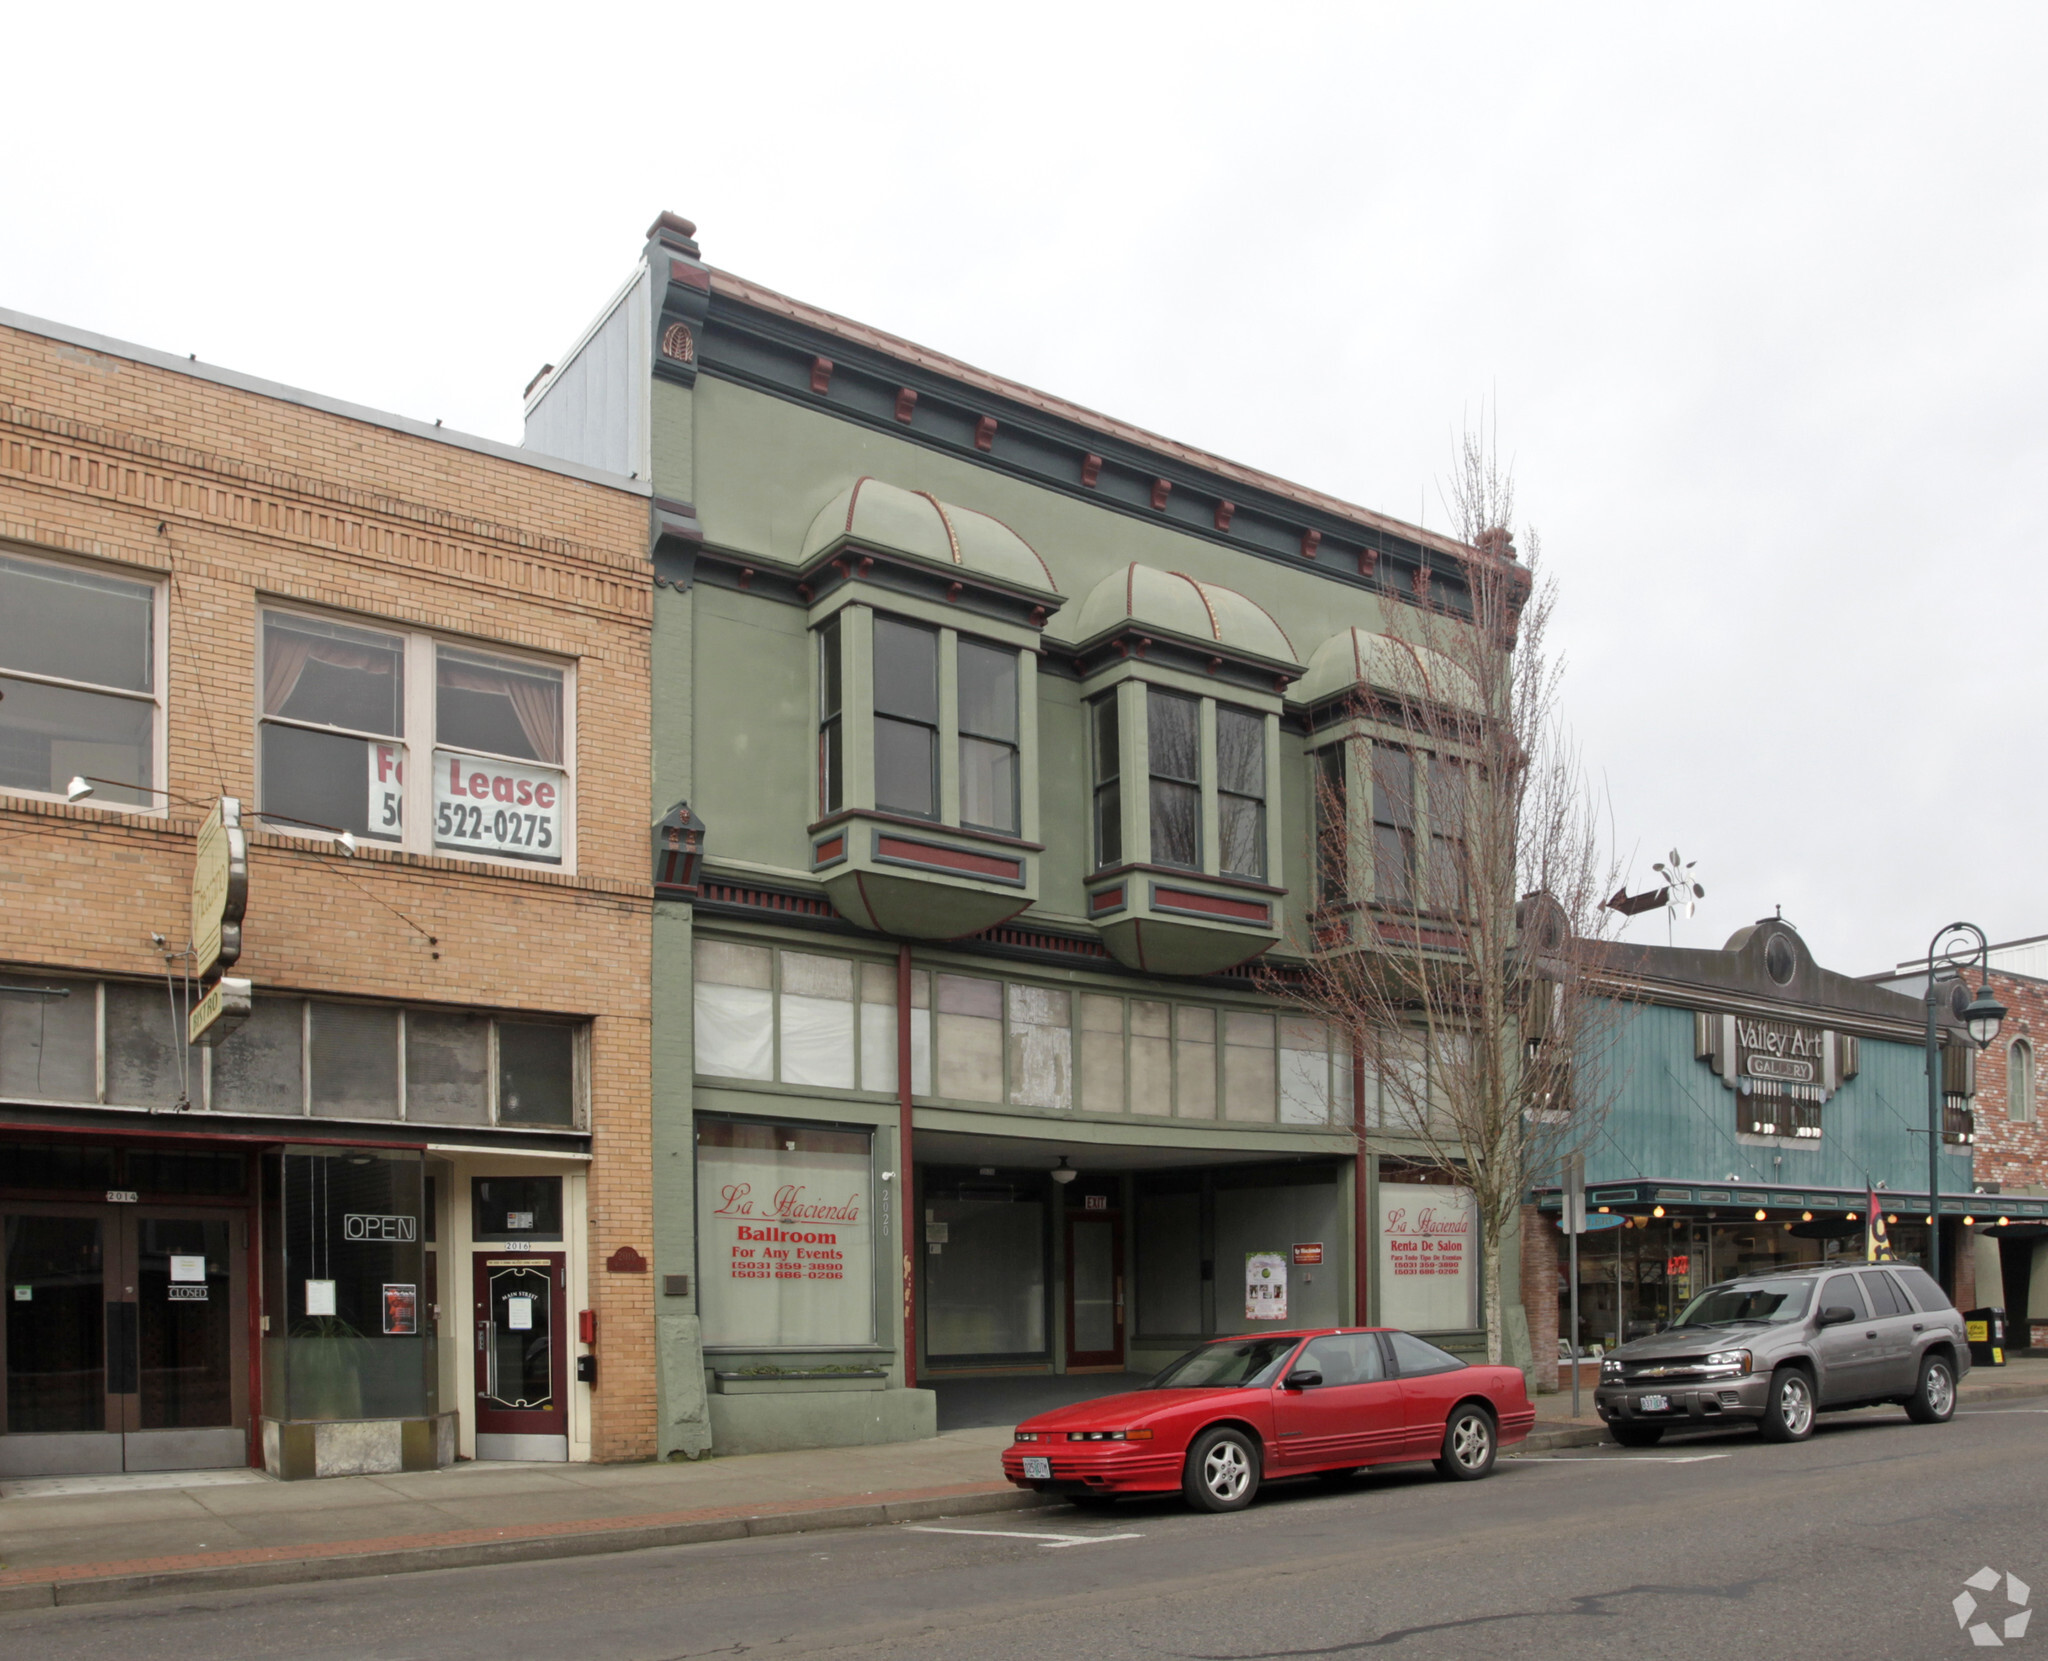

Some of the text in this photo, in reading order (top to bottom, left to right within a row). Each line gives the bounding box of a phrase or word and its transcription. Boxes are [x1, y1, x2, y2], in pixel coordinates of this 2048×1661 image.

[450, 758, 556, 809] Lease
[192, 991, 218, 1032] BISTRO
[1737, 1019, 1822, 1058] Valley Art
[1754, 1059, 1808, 1078] GALLERY
[108, 1191, 137, 1201] 2014
[713, 1183, 860, 1221] La Hacienda
[1087, 1196, 1105, 1209] EXIT
[882, 1190, 890, 1236] 2020
[1384, 1208, 1468, 1233] La Hacienda
[348, 1216, 413, 1239] OPEN
[737, 1225, 837, 1245] Ballroom
[506, 1242, 529, 1250] 2016
[732, 1246, 844, 1261] For Any Events
[1391, 1240, 1463, 1252] Renta De Salon
[775, 1262, 844, 1271] 359-3890
[775, 1271, 844, 1280] 686-0206
[169, 1288, 208, 1299] CLOSED
[502, 1291, 539, 1301] MAIN STREET
